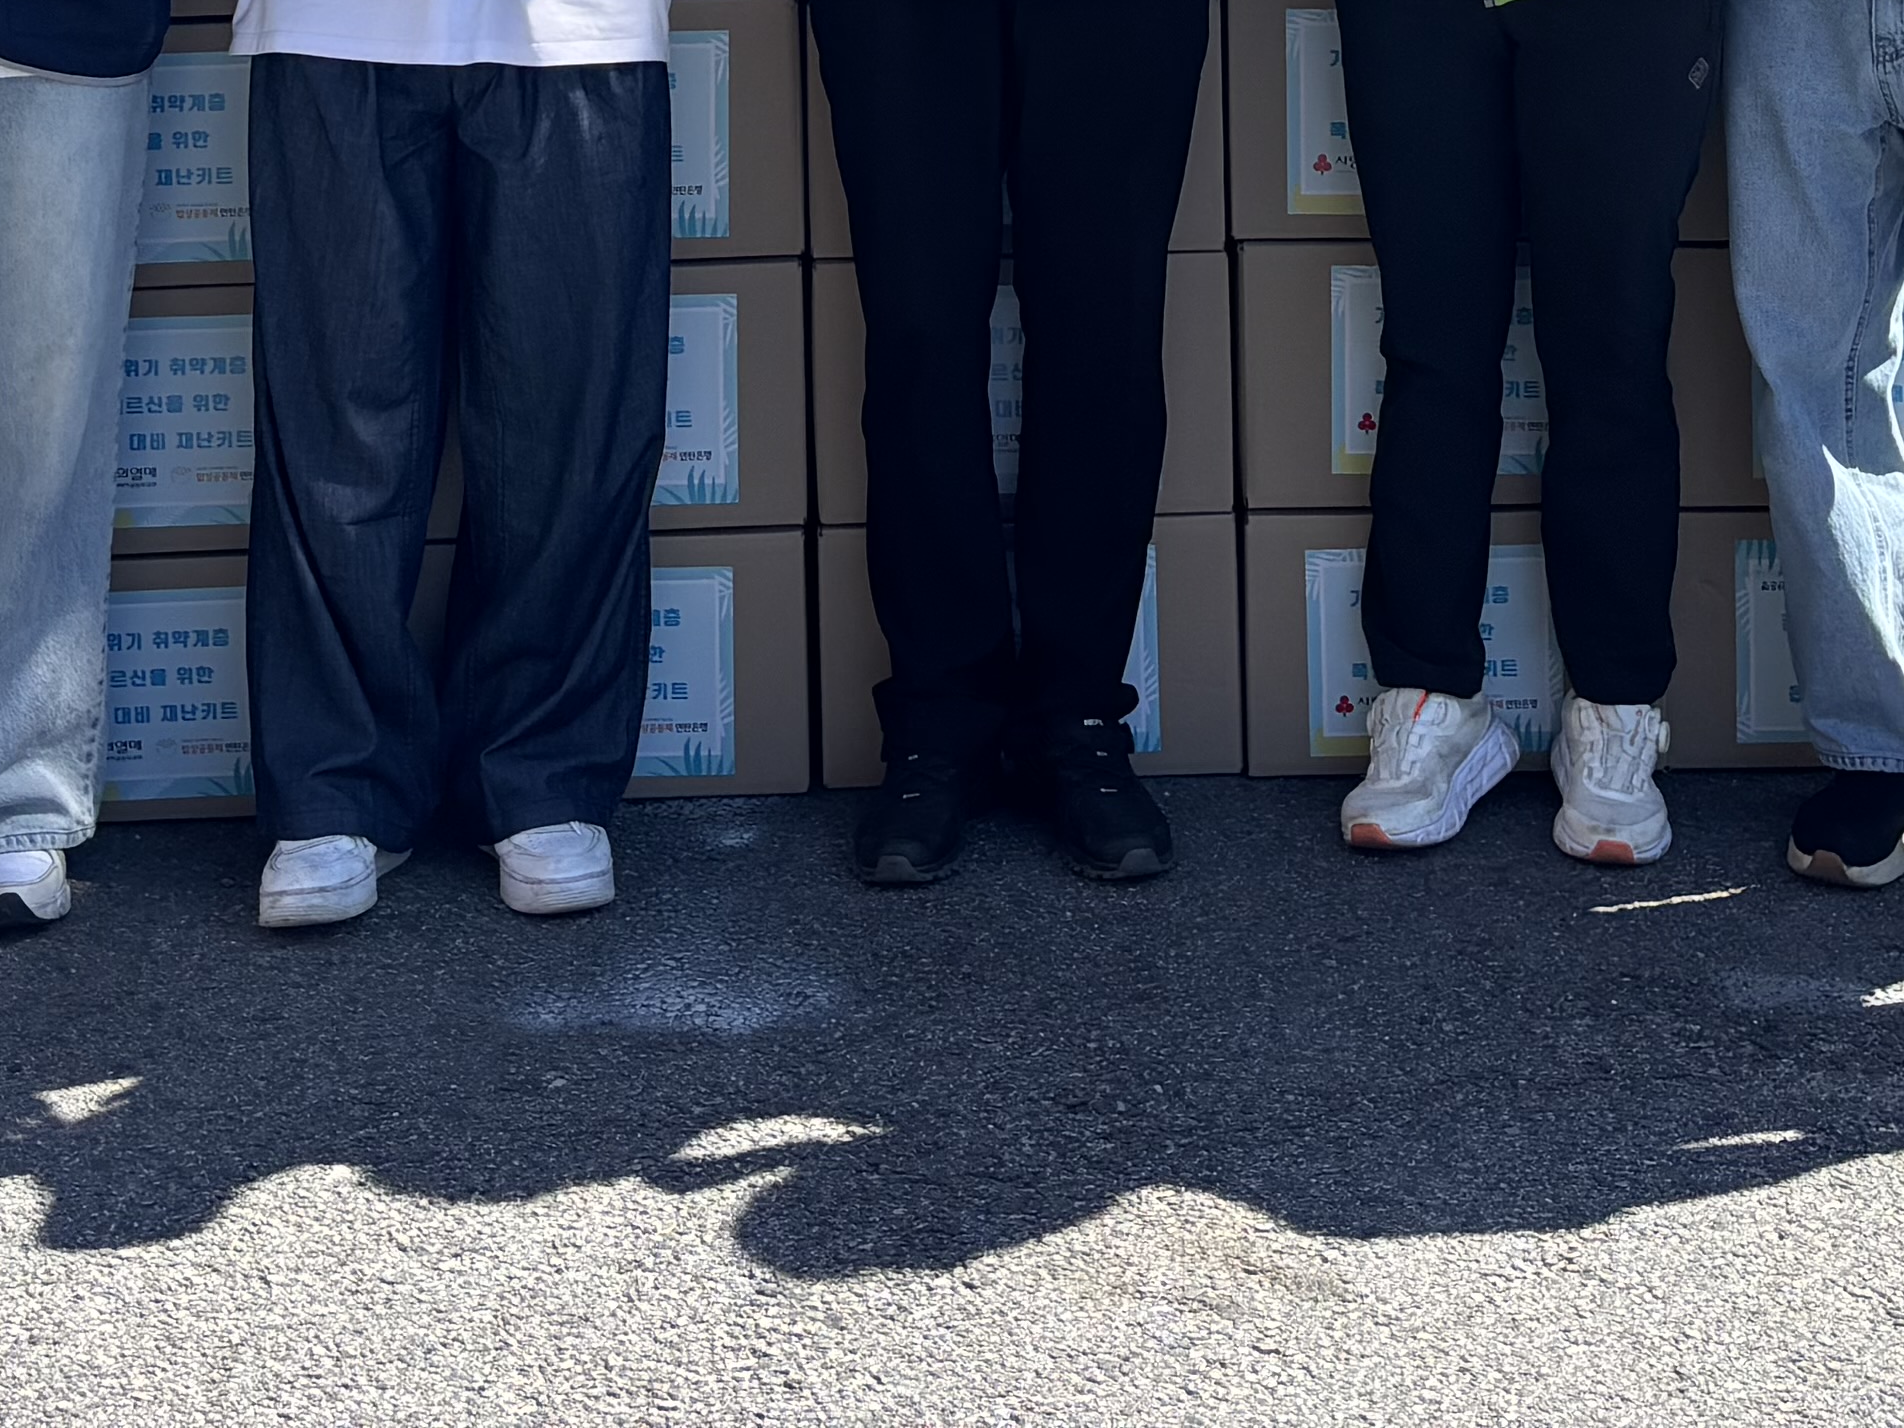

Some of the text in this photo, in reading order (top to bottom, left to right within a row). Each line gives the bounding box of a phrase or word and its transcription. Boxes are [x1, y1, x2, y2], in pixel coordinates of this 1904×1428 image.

[171, 130, 210, 149] 위한
[156, 166, 234, 186] 재난키트
[169, 355, 247, 376] 취약계층
[120, 393, 231, 416] 르신을 위한
[129, 430, 253, 451] 대비 재난키트
[152, 627, 230, 649] 취약계층
[176, 665, 214, 685] 위한
[114, 701, 239, 725] 대비 재난키트
